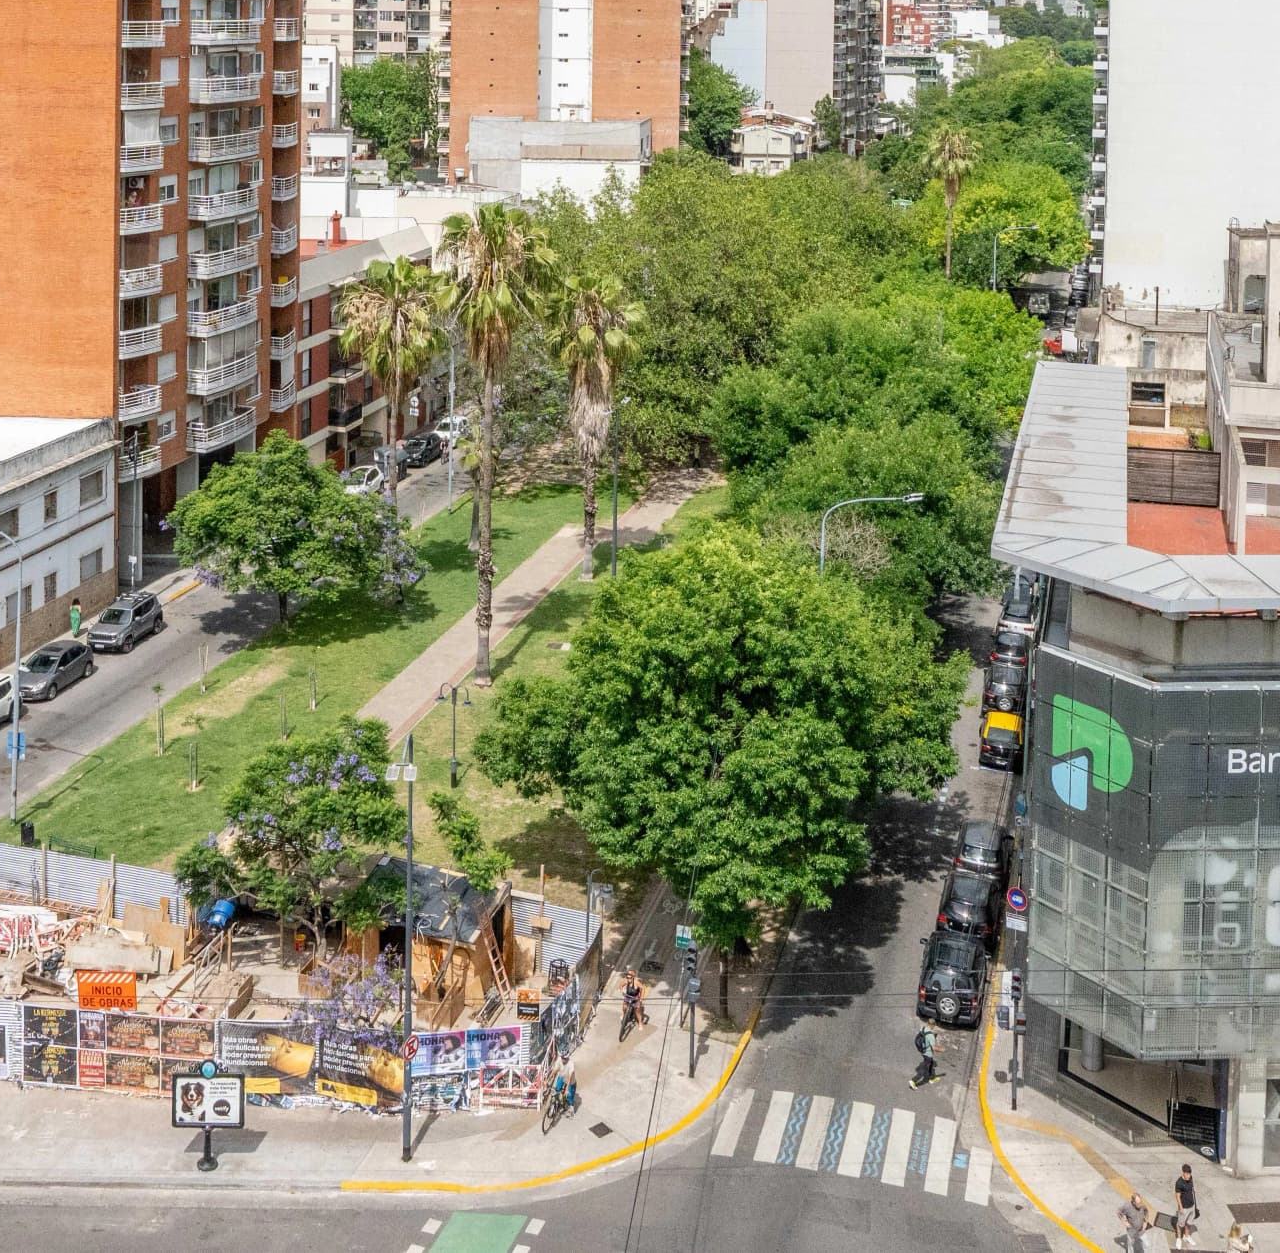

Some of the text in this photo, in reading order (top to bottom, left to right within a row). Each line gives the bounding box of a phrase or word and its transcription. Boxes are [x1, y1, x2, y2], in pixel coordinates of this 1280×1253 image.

[91, 986, 122, 996] INICIO
[82, 997, 134, 1008] DE OBRAS
